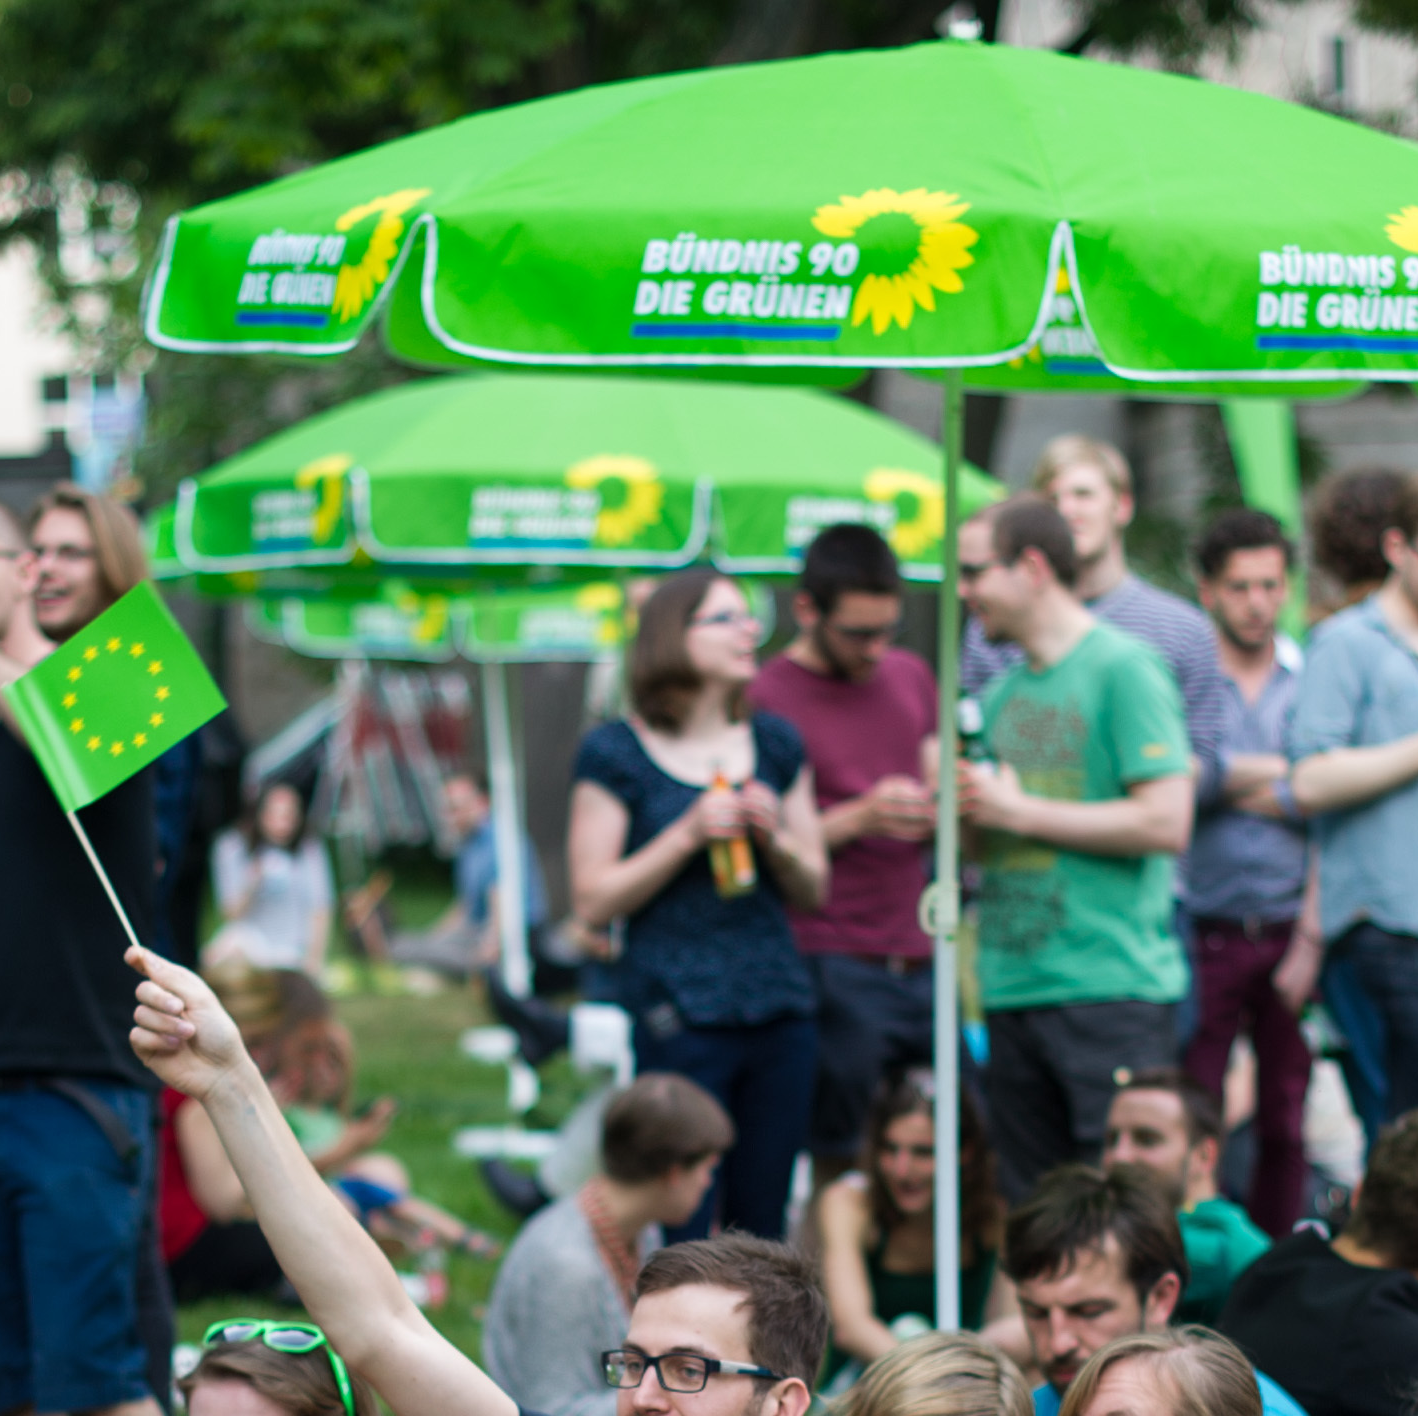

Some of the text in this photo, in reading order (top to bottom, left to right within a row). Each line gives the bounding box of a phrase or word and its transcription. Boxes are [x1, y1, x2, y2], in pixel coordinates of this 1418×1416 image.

[641, 232, 860, 277] BÜNDNIS 90
[1258, 245, 1396, 287] BÜNDNIS
[633, 274, 853, 319] DIE GRÜNEN
[1256, 291, 1308, 328] DIE
